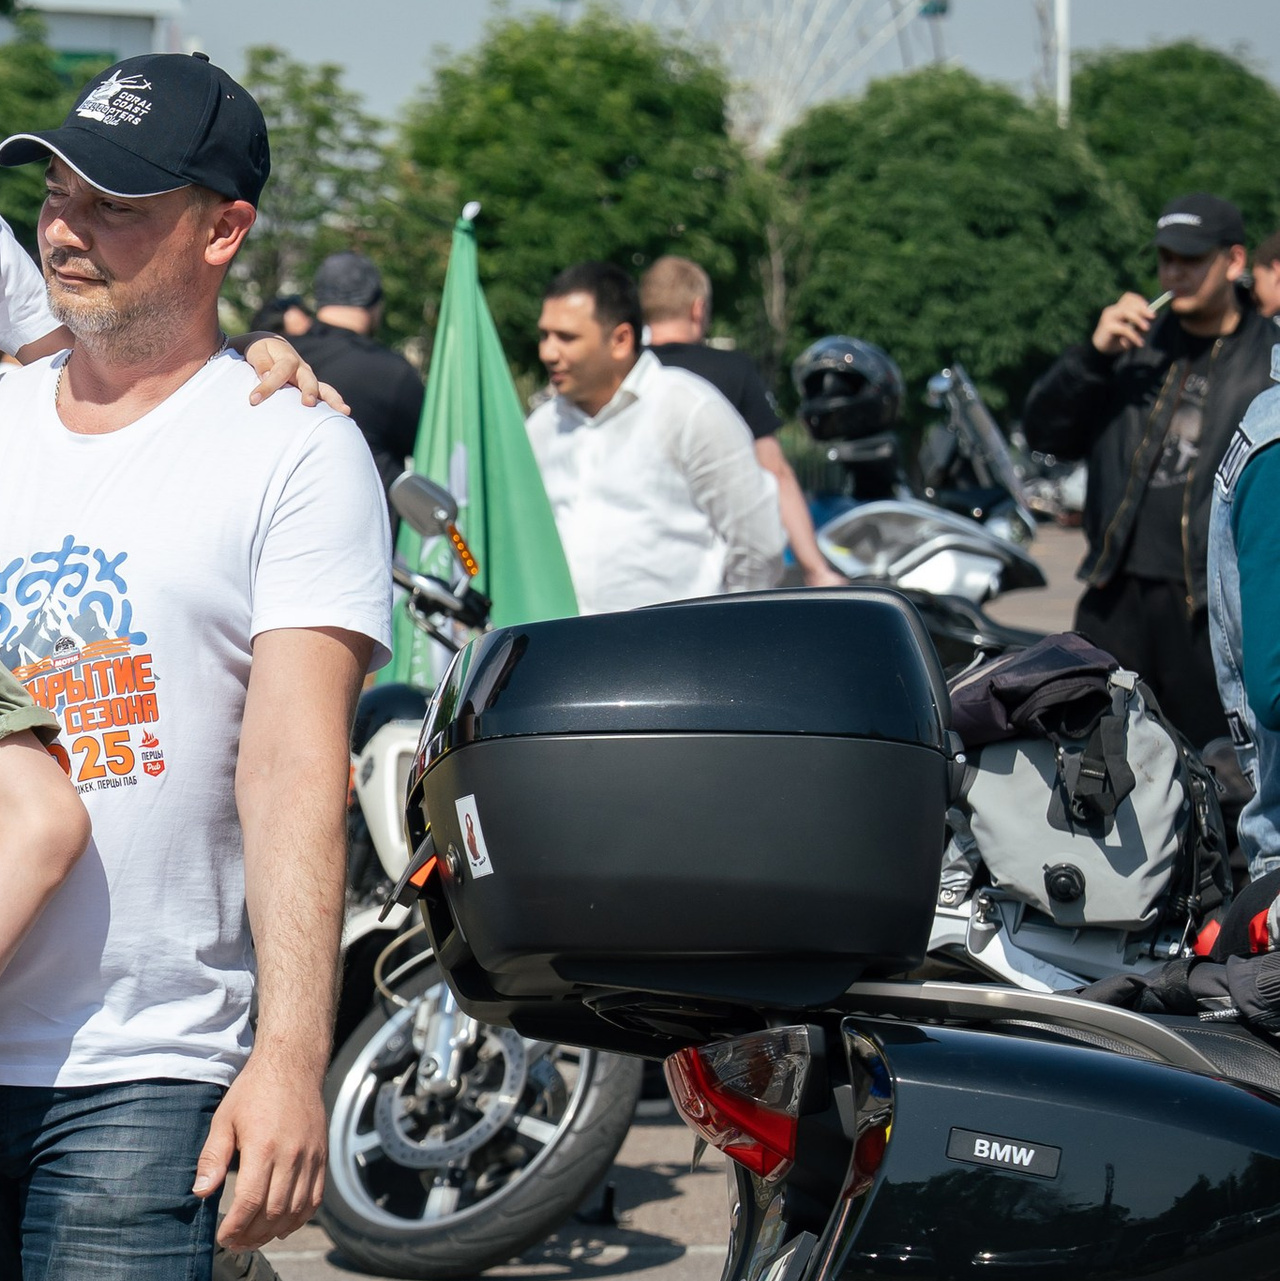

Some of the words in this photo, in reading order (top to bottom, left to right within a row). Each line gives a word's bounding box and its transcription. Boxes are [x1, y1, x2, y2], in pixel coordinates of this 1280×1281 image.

[112, 98, 148, 116] COAST
[119, 91, 152, 111] CORAL
[26, 654, 156, 709] КРЫТИЕ
[64, 693, 159, 735] СЕЗОНА
[141, 750, 163, 760] ПЕРЦЫ
[97, 778, 123, 790] ПЕРЦЫ
[124, 776, 138, 786] ПАБ
[974, 1138, 1035, 1166] BMW
